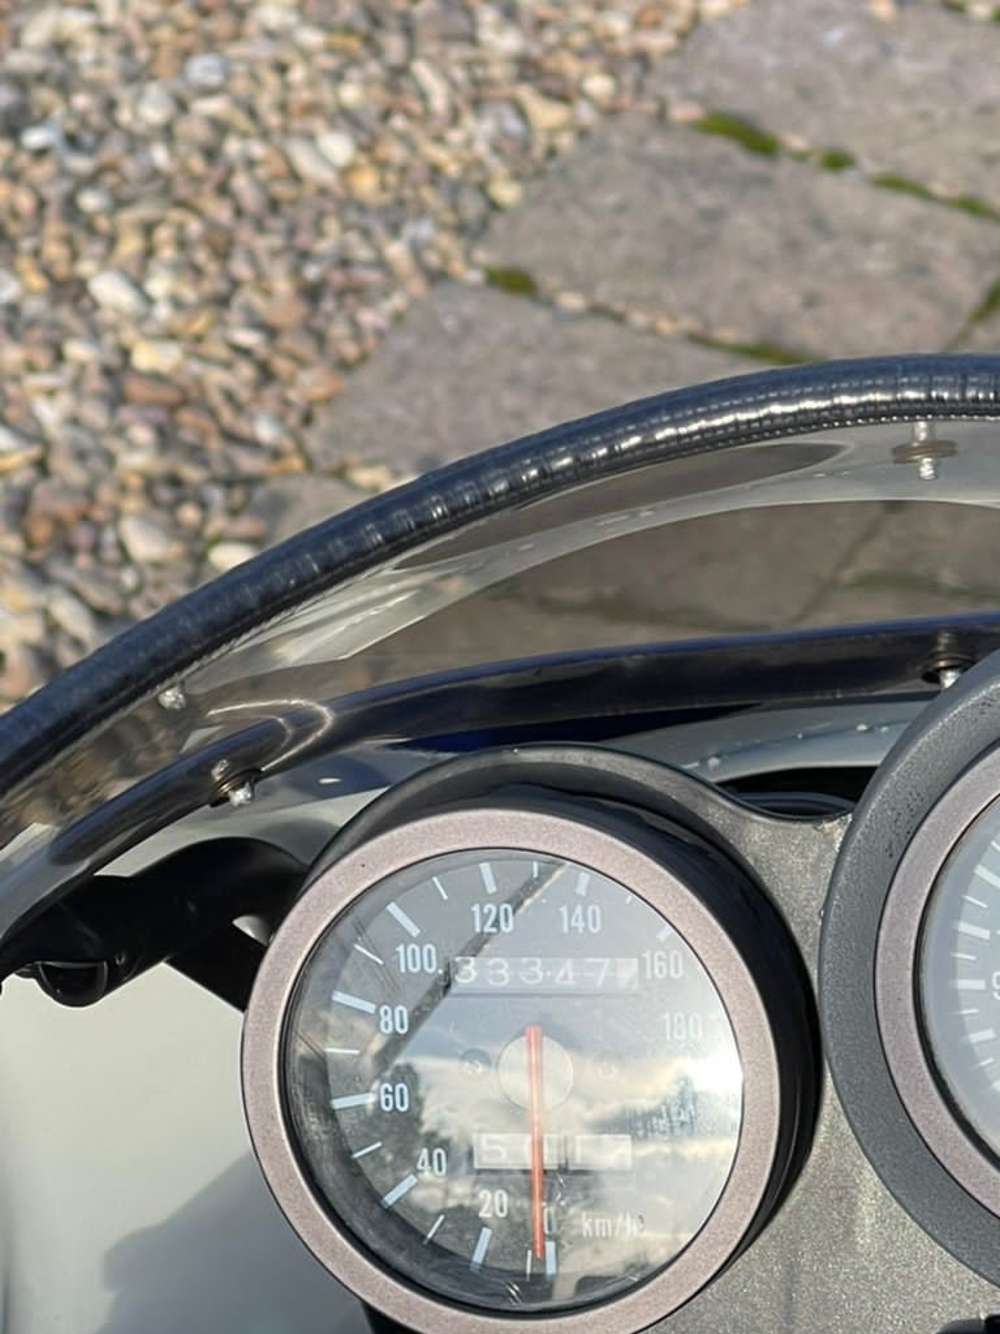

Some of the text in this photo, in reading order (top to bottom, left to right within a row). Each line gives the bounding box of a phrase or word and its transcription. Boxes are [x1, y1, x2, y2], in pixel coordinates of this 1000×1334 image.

[472, 904, 514, 934] 120
[560, 906, 601, 934] 140
[396, 944, 437, 974] 100
[643, 950, 683, 979] 160
[379, 1005, 408, 1034] 80
[663, 1012, 702, 1041] 180
[379, 1083, 408, 1111] 60
[417, 1149, 446, 1176] 40
[478, 1189, 508, 1218] 20
